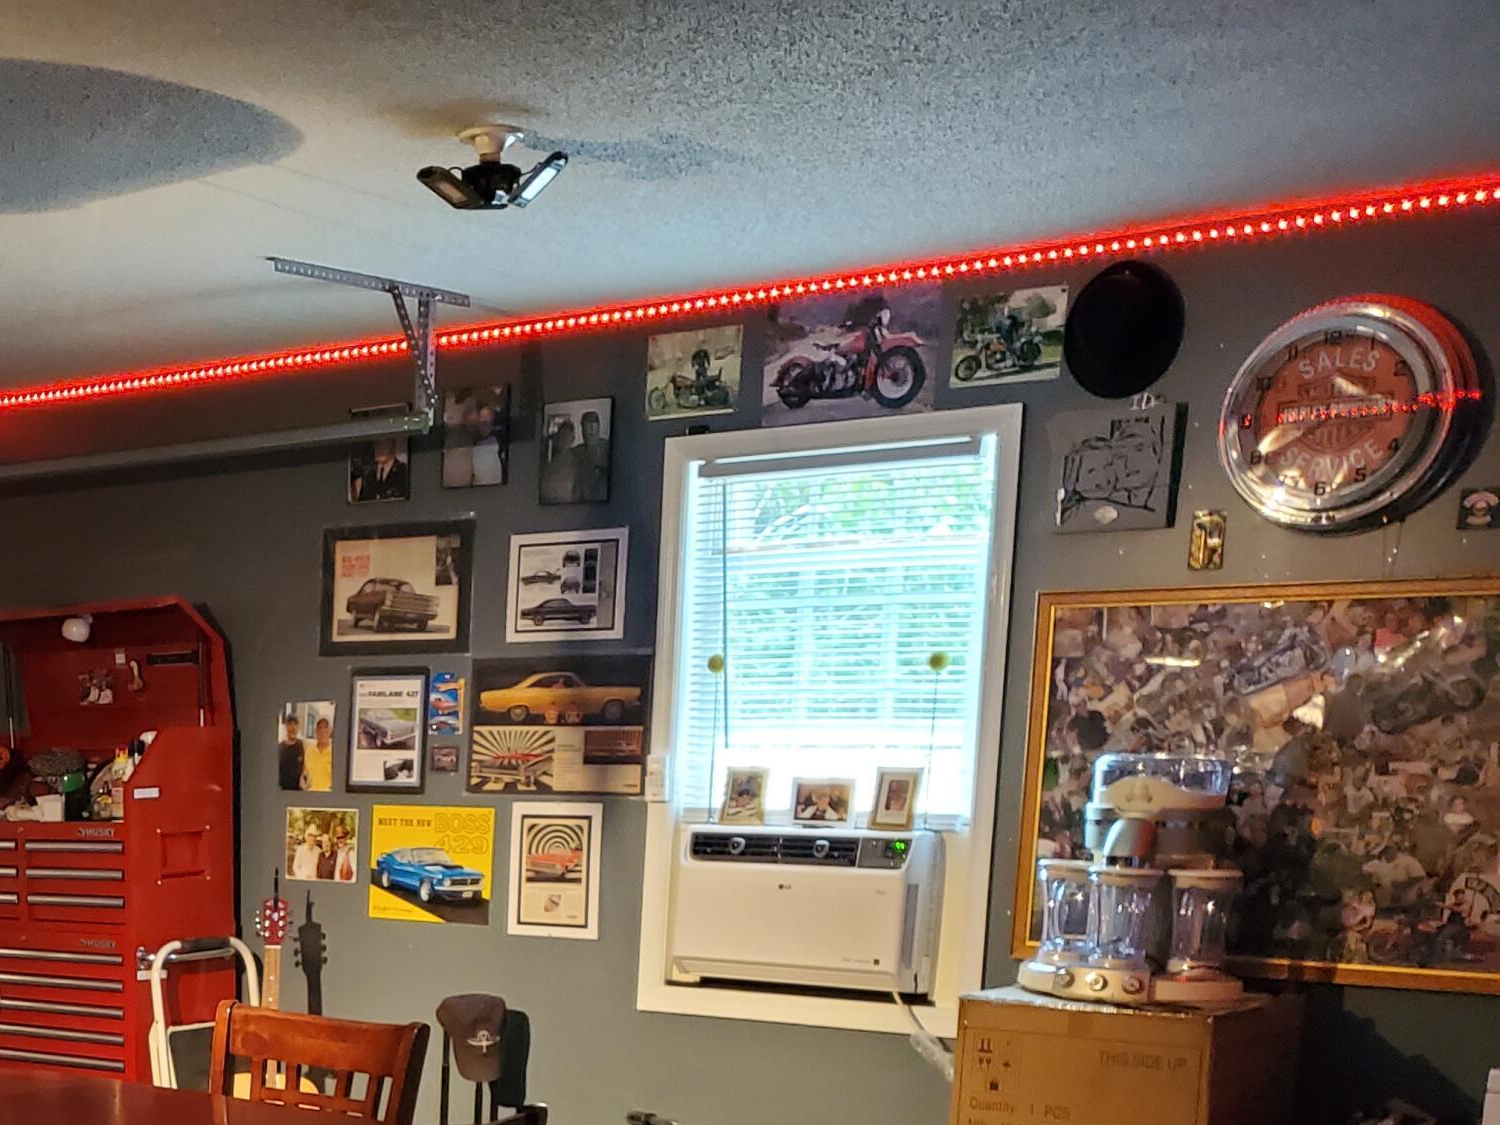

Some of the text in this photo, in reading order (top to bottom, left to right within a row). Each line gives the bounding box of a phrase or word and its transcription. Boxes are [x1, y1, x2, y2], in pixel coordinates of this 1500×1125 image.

[1299, 347, 1380, 380] SALES
[1280, 438, 1383, 475] SERVICE
[1354, 467, 1367, 482] 5
[1314, 481, 1326, 496] 6
[378, 817, 431, 828] MEET THE NEW
[434, 812, 491, 834] BOSS
[434, 834, 489, 855] 429
[1167, 1055, 1188, 1071] UP
[1043, 1105, 1071, 1121] PCS
